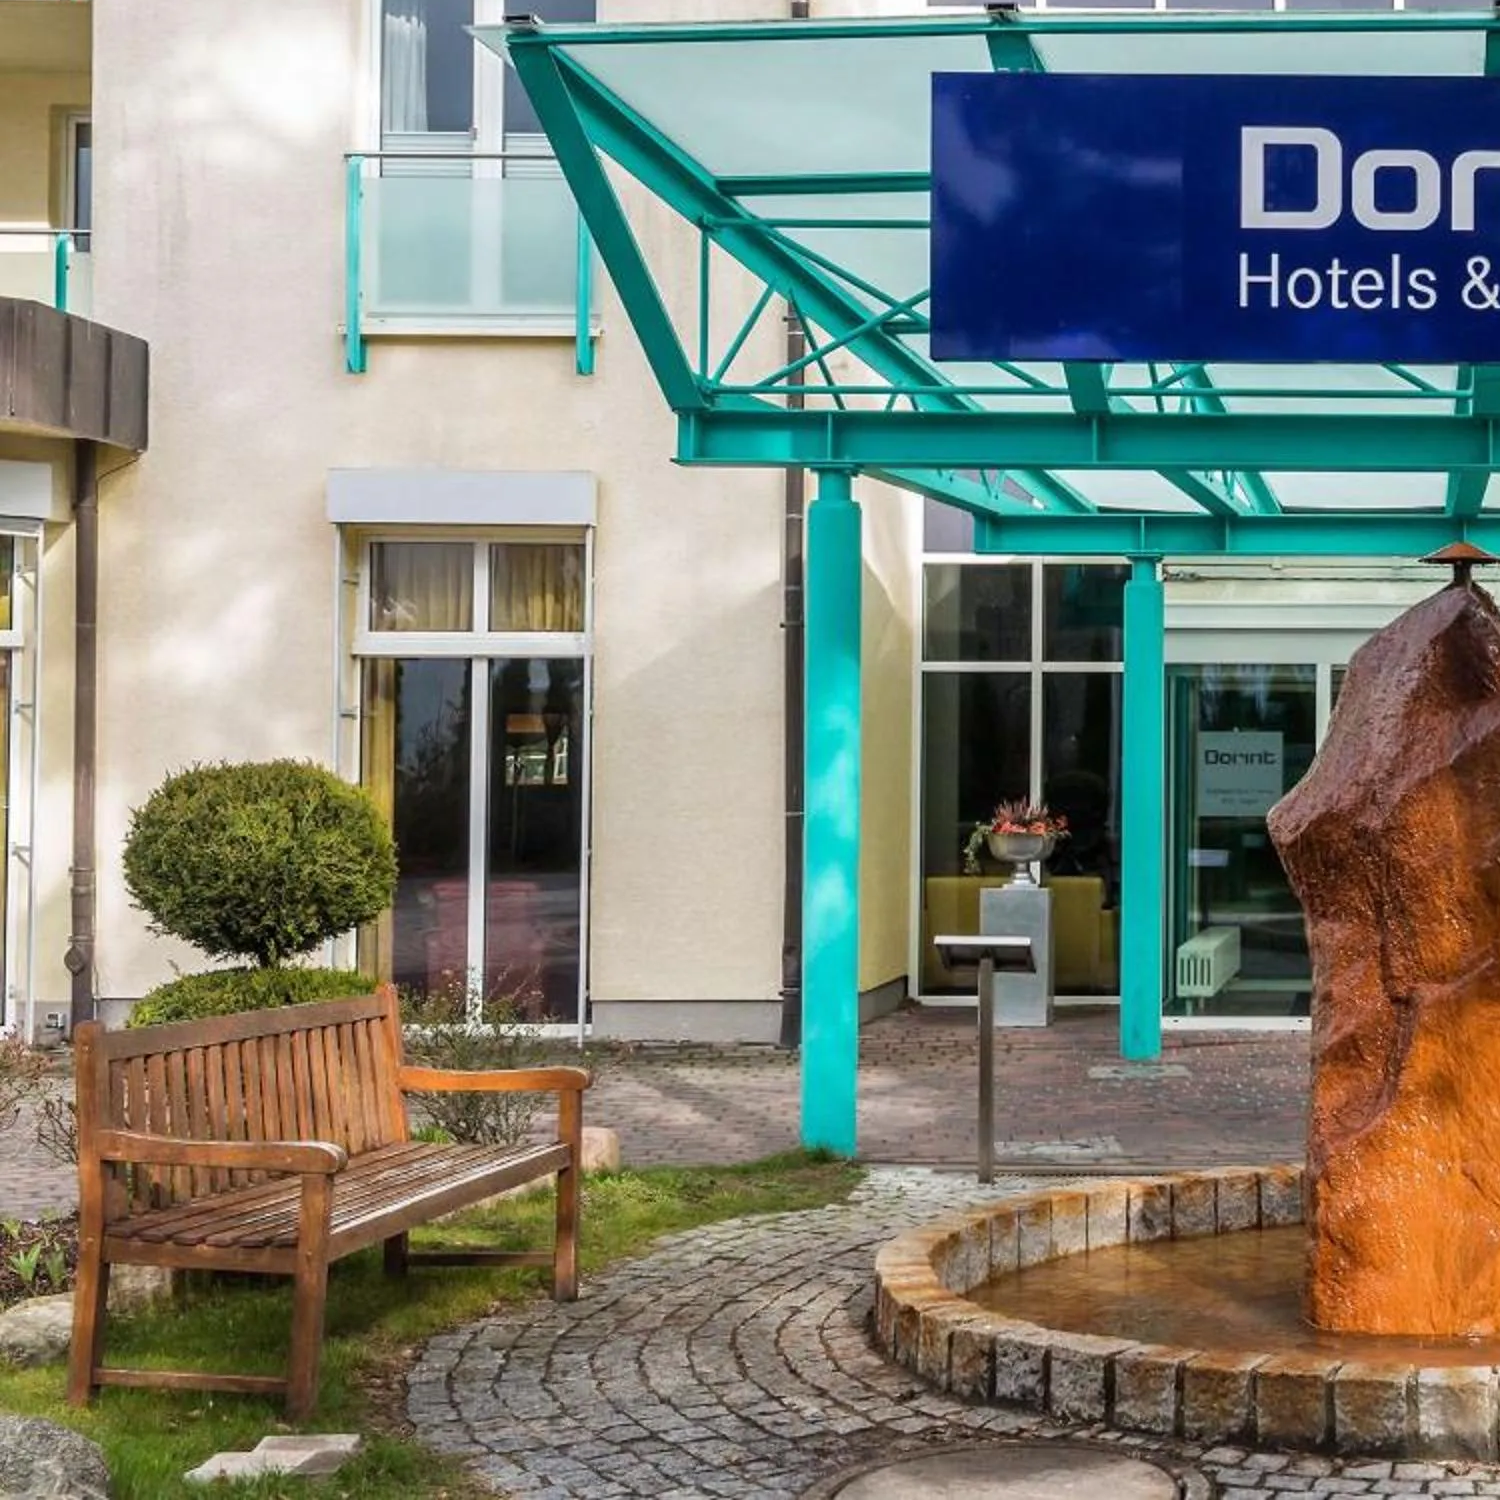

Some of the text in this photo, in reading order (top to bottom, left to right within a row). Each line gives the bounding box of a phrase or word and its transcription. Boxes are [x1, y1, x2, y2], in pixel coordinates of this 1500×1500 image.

[1240, 253, 1437, 309] Hotels
[1462, 256, 1500, 309] &
[1204, 749, 1277, 765] Dorint
